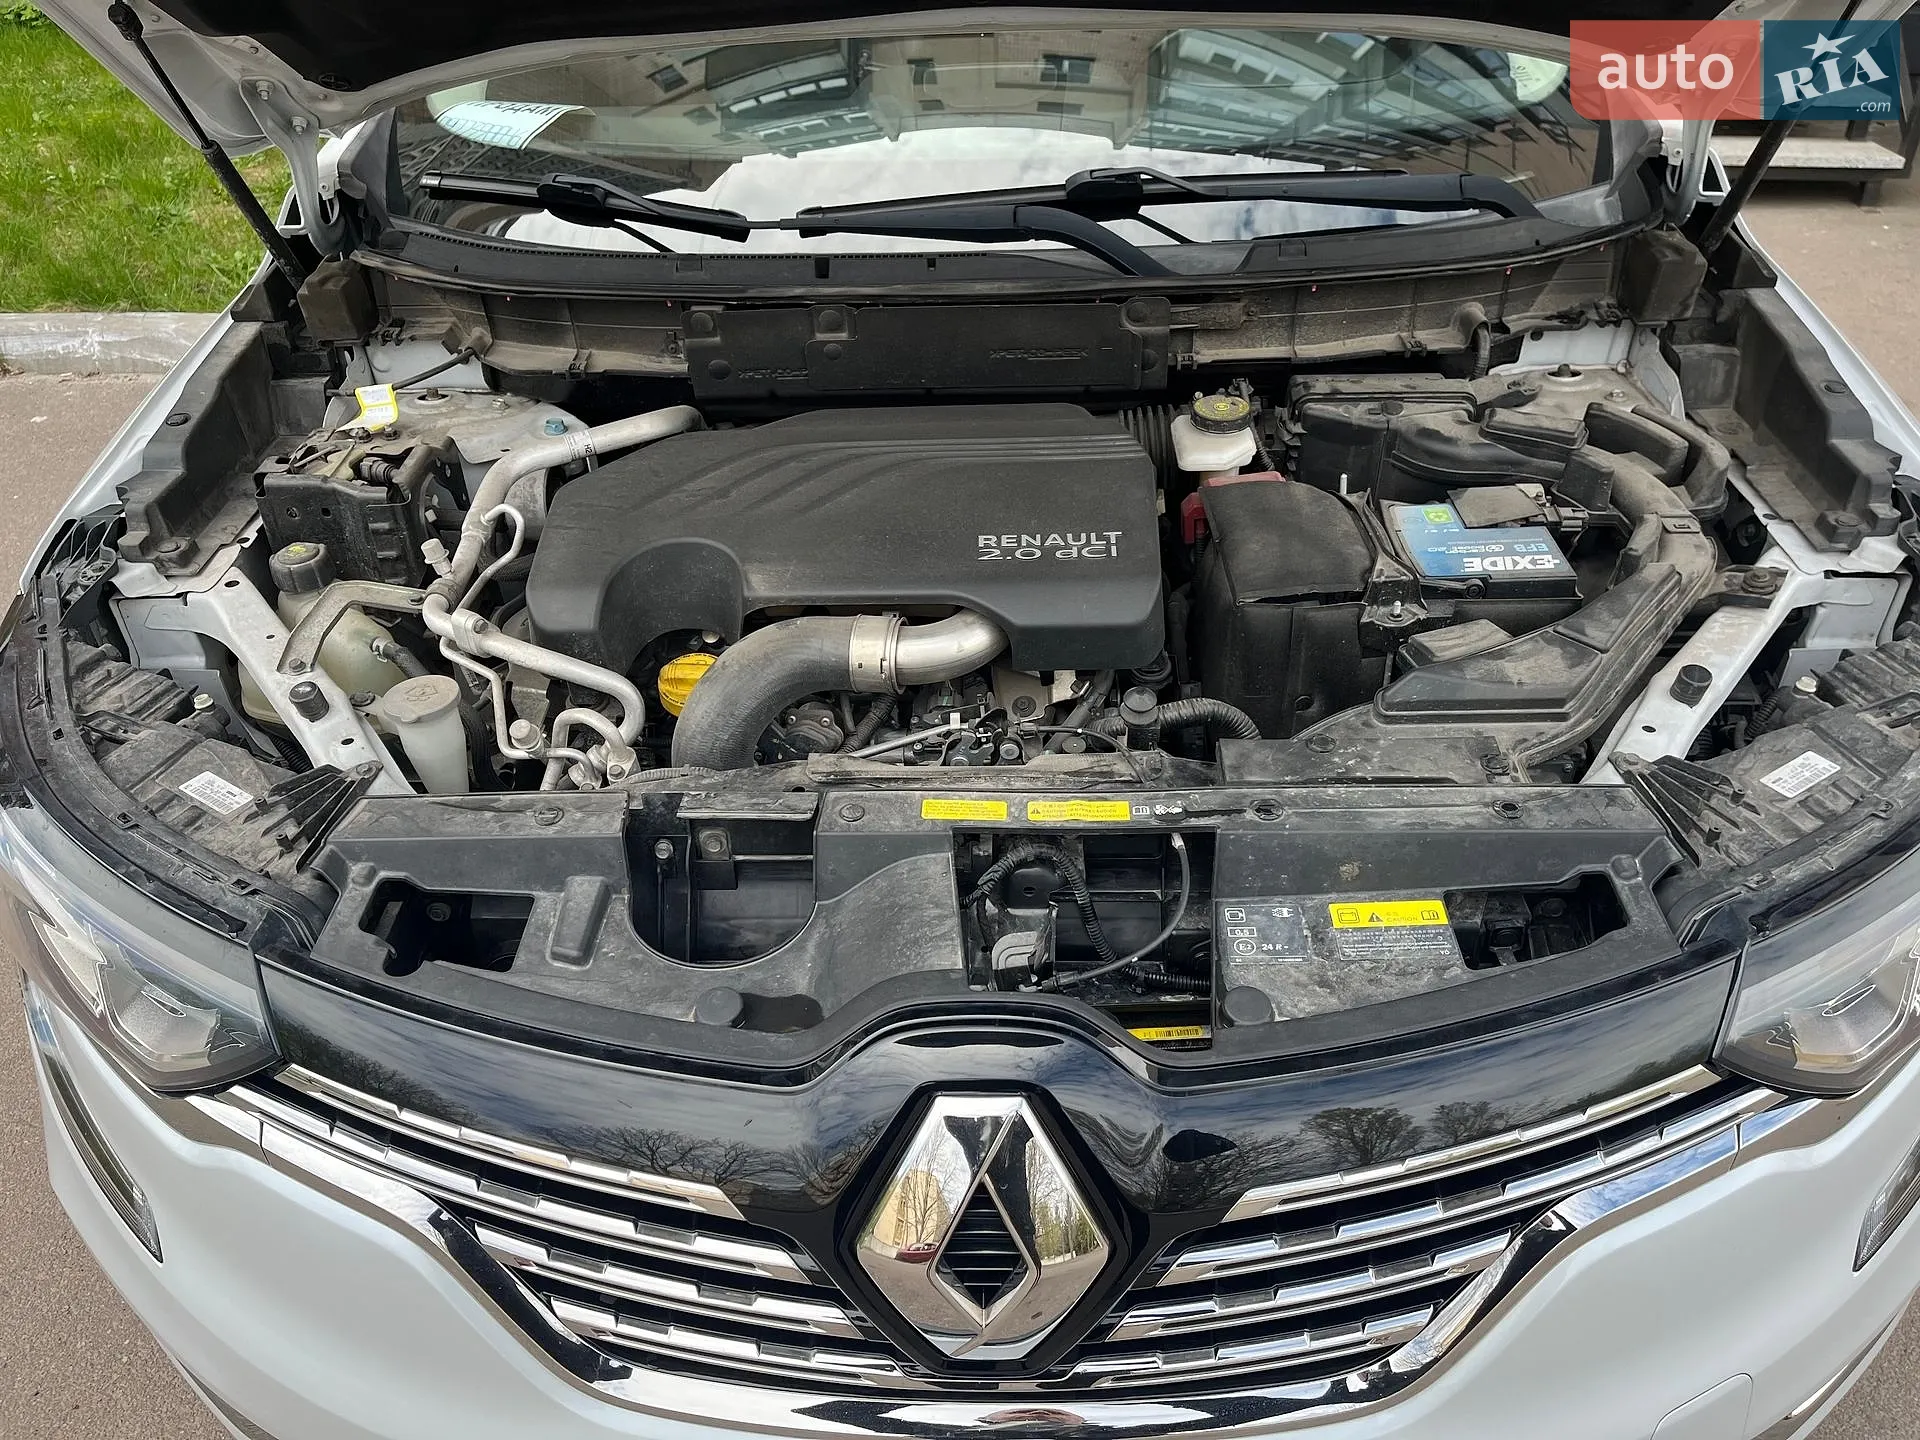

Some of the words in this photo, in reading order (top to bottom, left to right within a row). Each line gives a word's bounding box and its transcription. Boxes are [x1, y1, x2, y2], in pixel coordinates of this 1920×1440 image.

[978, 532, 1122, 547] RENAULT
[977, 548, 1042, 560] 2.0
[1513, 543, 1549, 553] EFB
[1463, 554, 1558, 572] EXIDE
[1262, 943, 1273, 951] 24
